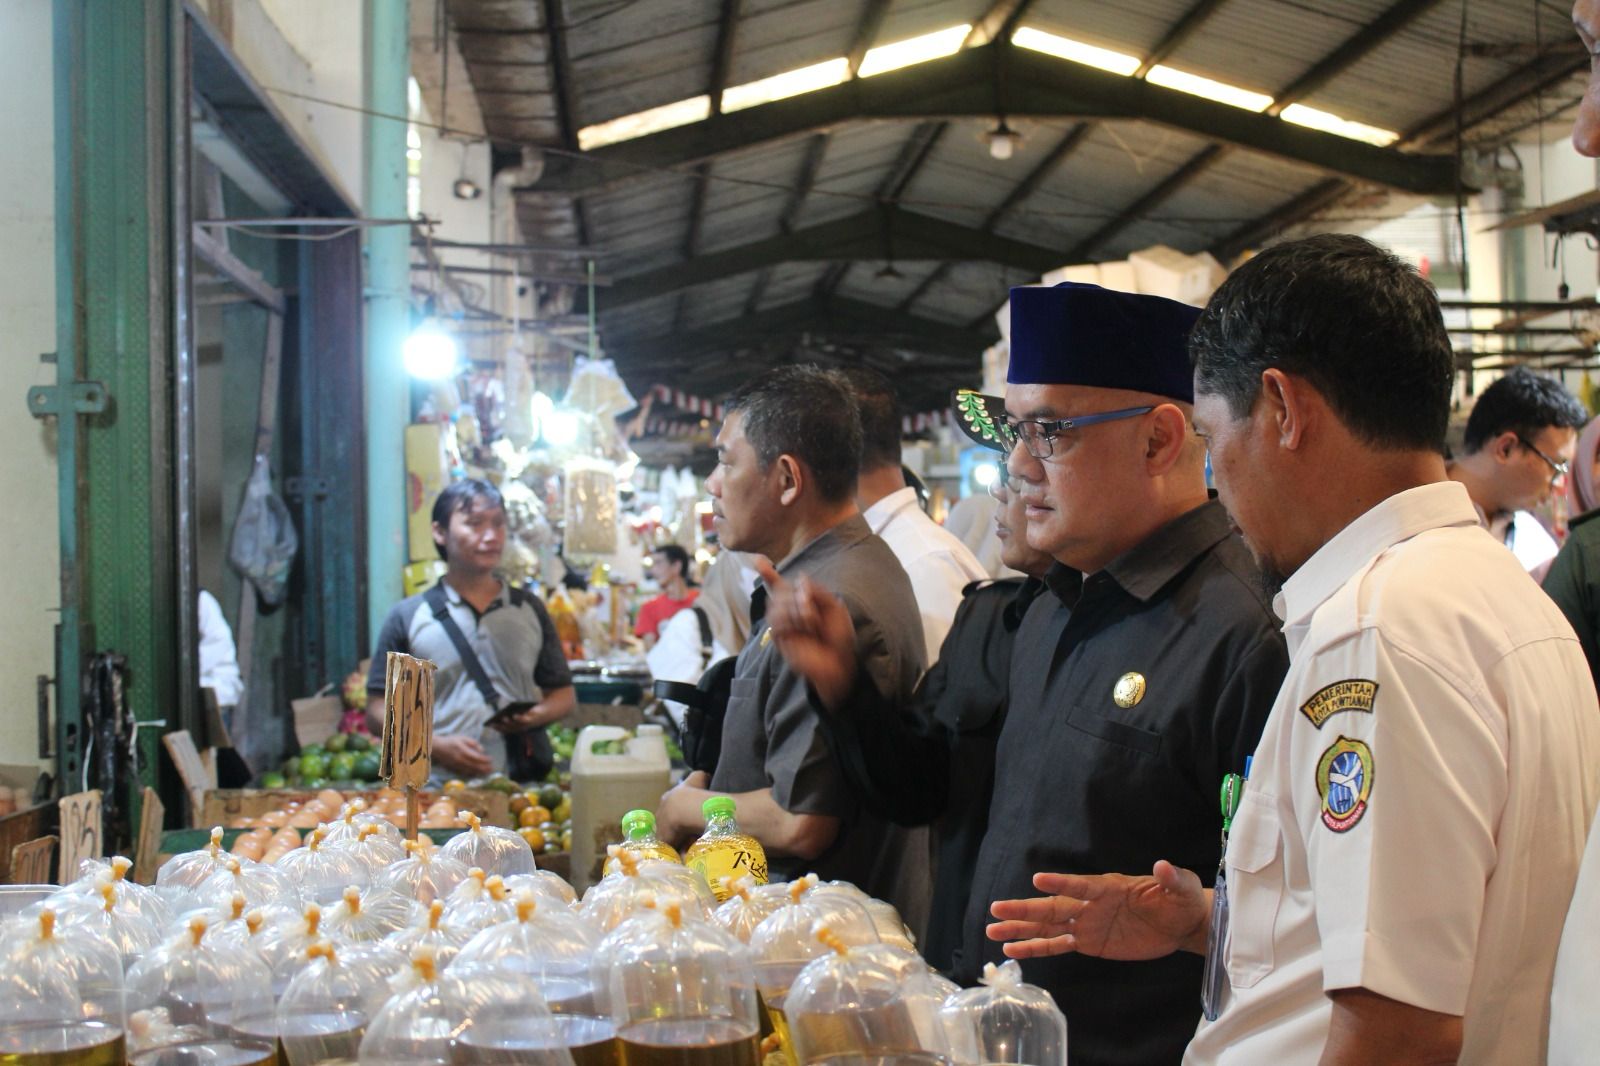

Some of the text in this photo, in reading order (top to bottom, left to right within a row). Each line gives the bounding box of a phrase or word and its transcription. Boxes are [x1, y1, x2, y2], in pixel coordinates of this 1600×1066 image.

[1309, 683, 1372, 712] PEMERINTAH
[1313, 695, 1371, 722] KOTA PONTIANAK
